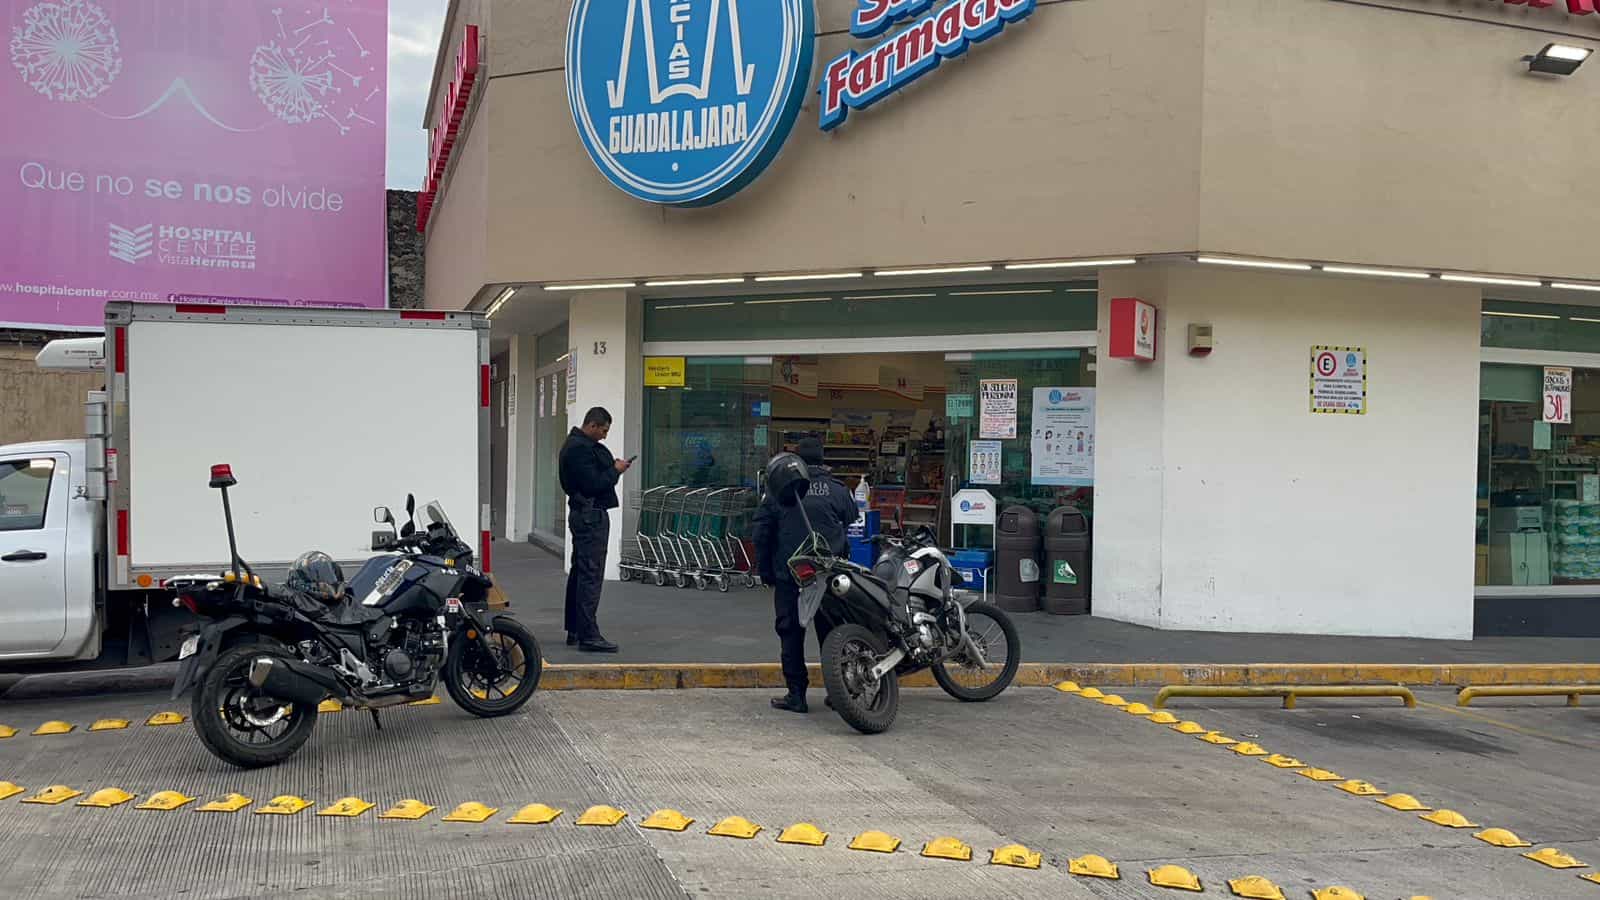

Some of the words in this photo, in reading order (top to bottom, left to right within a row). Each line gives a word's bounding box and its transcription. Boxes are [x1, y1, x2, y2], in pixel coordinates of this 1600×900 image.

[668, 0, 690, 80] CIAS
[609, 102, 749, 155] GUADALAJARA
[20, 162, 85, 190] Que
[96, 175, 134, 195] no
[144, 179, 183, 198] se
[194, 183, 251, 204] nos
[262, 185, 344, 211] olvide
[159, 225, 256, 244] HOSPITAL
[159, 239, 256, 257] CENTER
[159, 255, 256, 270] VistaHermosa
[0, 281, 160, 300] w.hospitalcenter.com.mx
[593, 341, 607, 355] 13
[1323, 358, 1331, 371] E
[1545, 394, 1562, 420] 30
